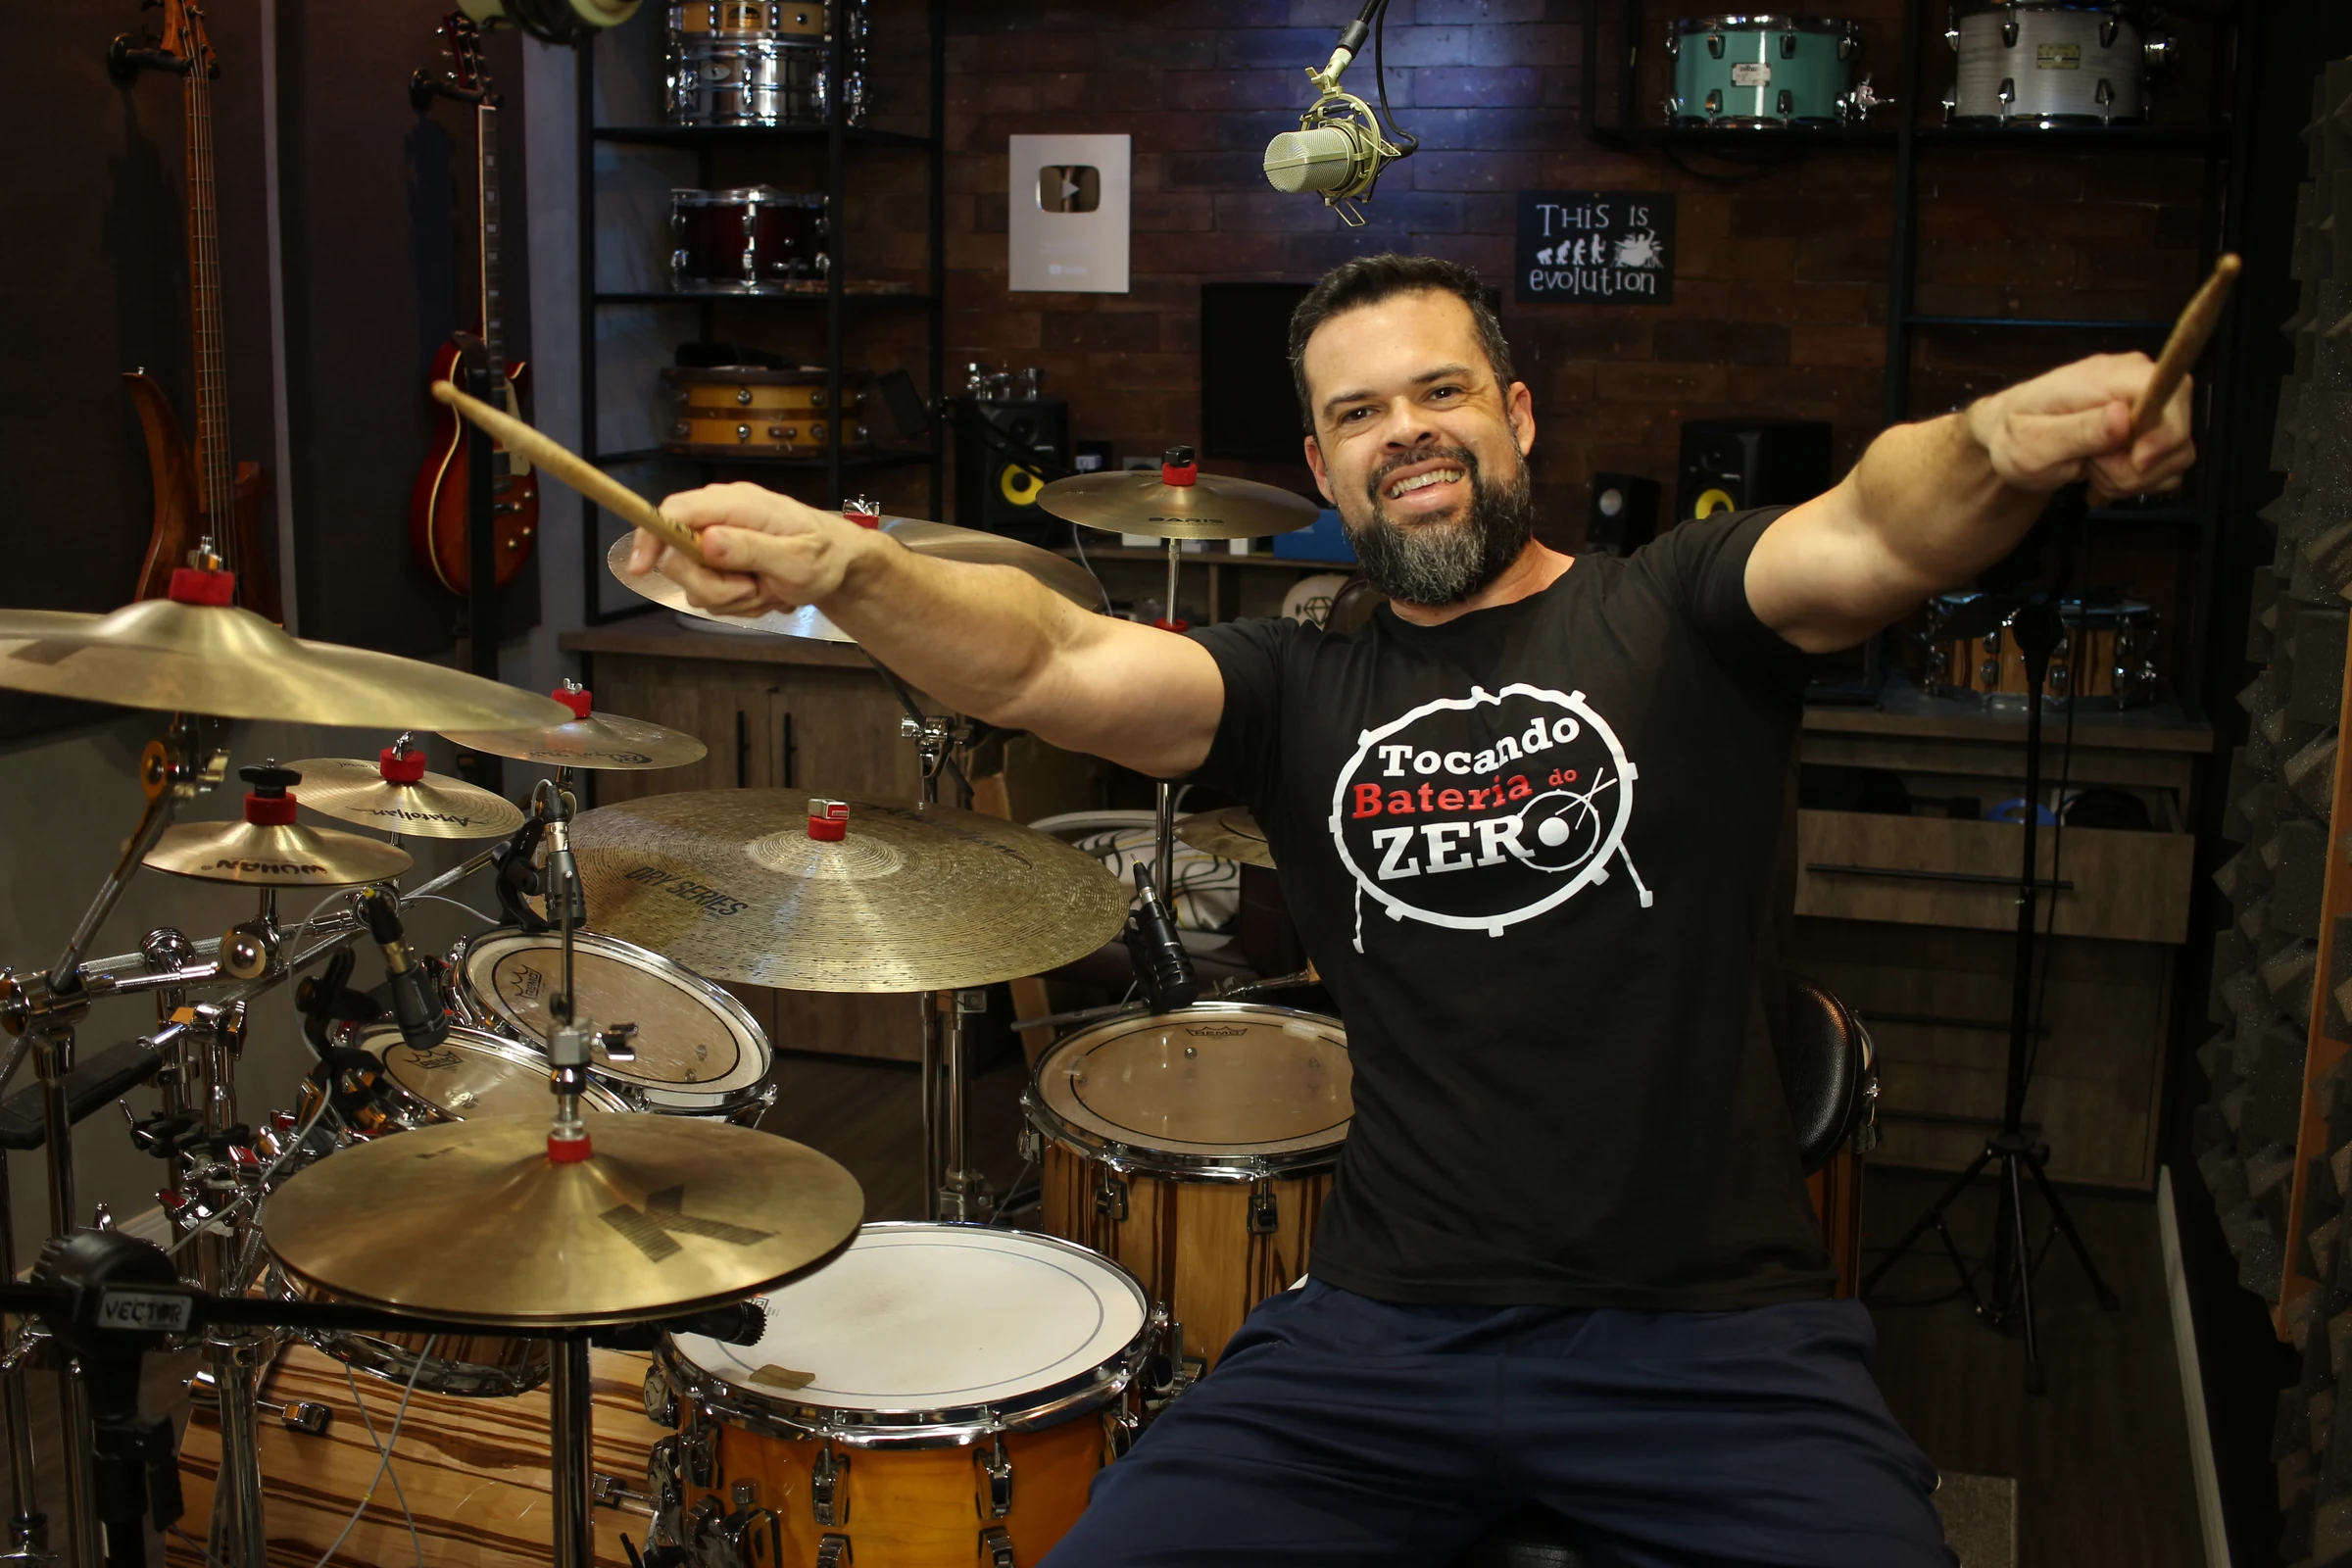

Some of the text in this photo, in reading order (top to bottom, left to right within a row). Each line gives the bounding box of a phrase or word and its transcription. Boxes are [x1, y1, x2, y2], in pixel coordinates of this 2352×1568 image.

[1529, 267, 1655, 295] evolution
[1378, 716, 1580, 777] Tocando
[1351, 768, 1577, 819] Bateria do
[217, 859, 328, 875] WUHAN
[624, 866, 749, 915] DRY SERIES
[105, 1300, 182, 1323] VECTOR
